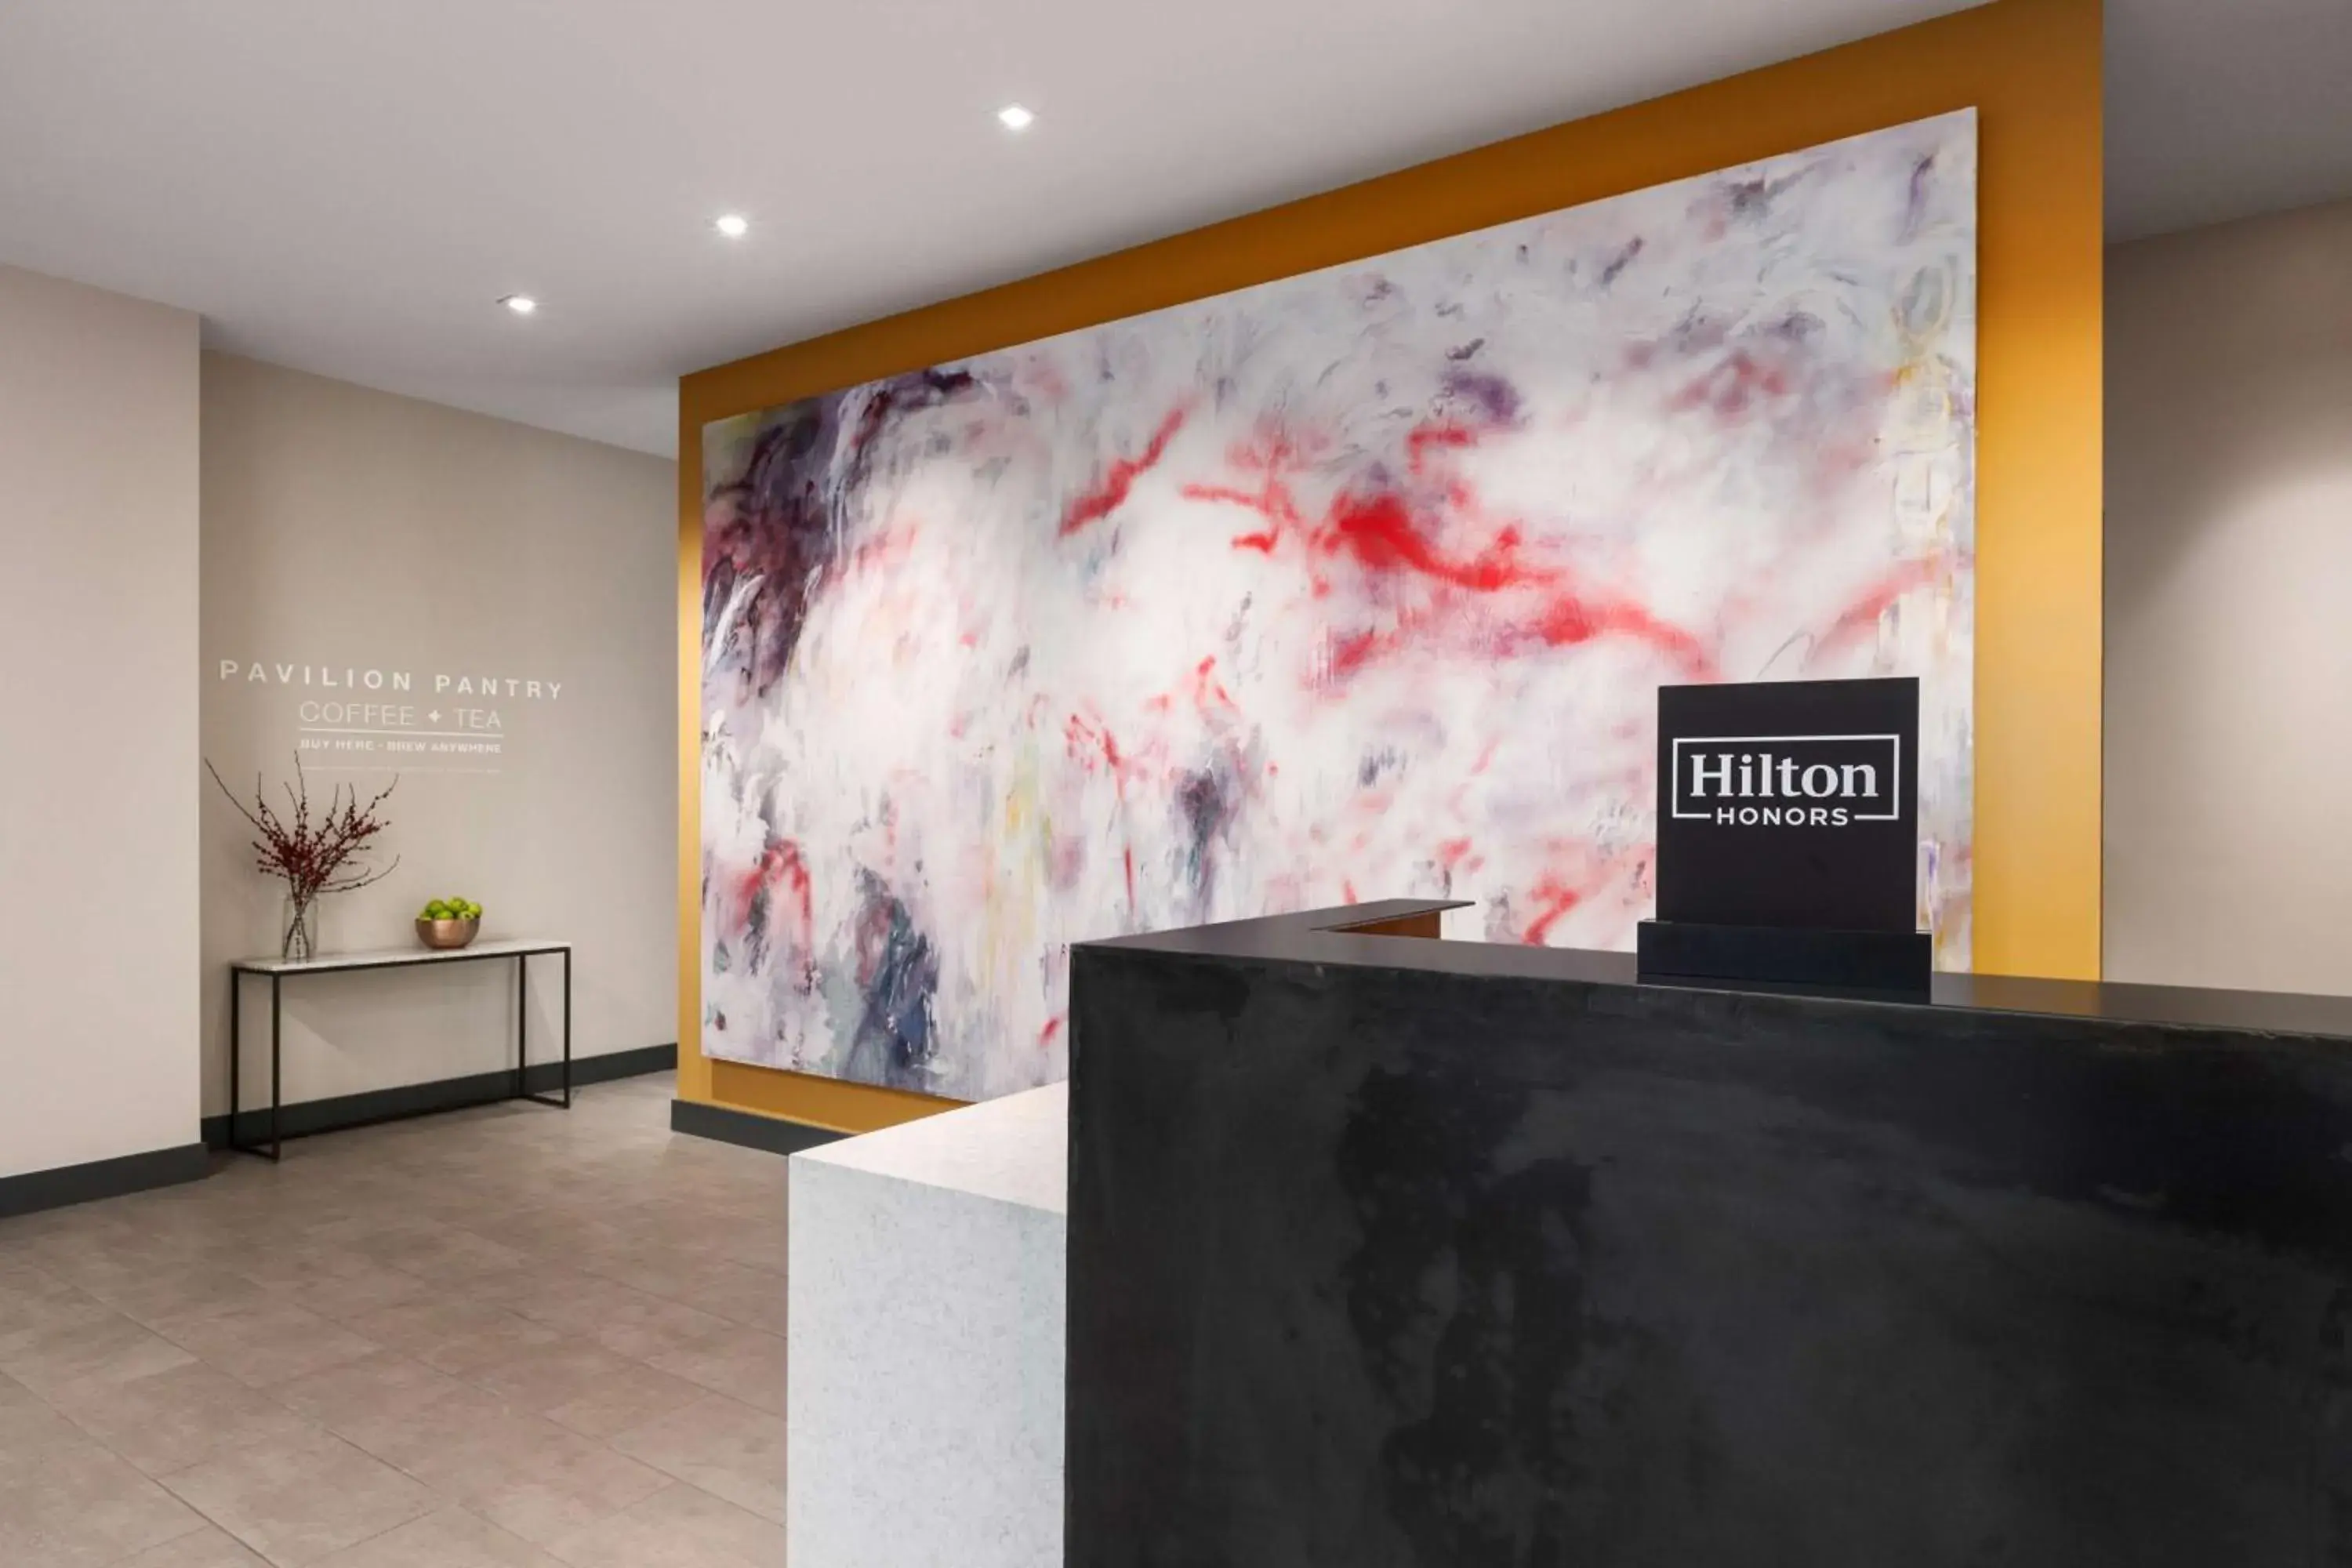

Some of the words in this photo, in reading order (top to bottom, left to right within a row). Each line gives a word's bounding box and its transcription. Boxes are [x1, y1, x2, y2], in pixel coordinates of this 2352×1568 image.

[220, 659, 411, 691] PAVILION
[434, 674, 561, 700] PANTRY
[299, 700, 415, 726] COFFEE
[456, 708, 502, 729] TEA
[300, 739, 329, 750] BUY
[1690, 753, 1879, 798] Hilton
[1717, 807, 1849, 826] HONORS
